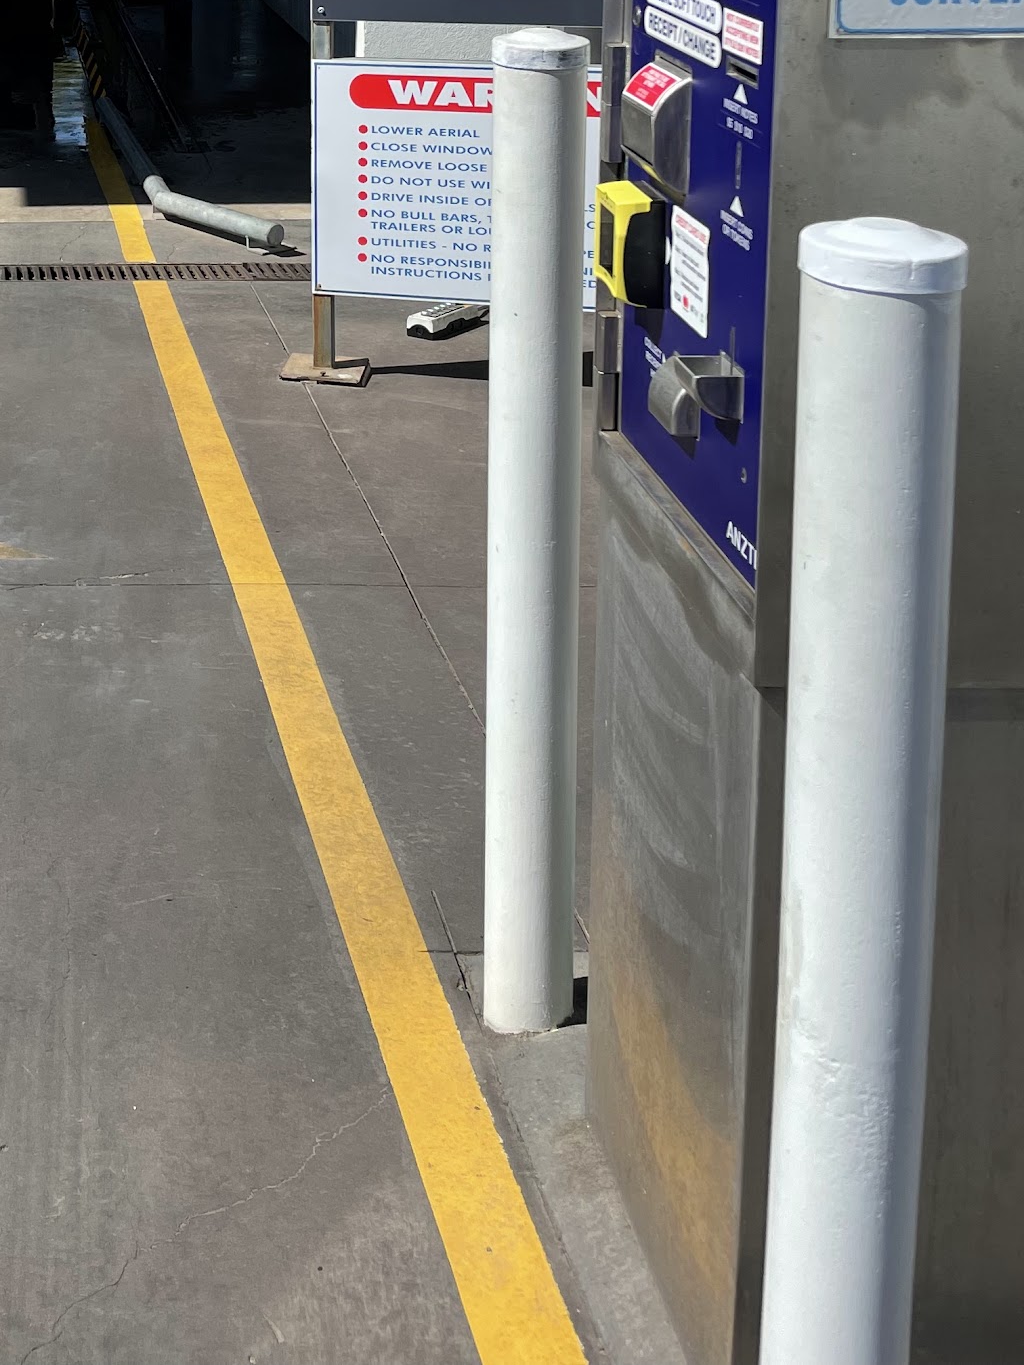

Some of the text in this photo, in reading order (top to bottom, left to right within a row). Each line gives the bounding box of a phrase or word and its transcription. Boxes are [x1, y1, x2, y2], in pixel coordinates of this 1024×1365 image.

[649, 12, 678, 42] RECEIPT
[683, 28, 716, 61] CHANGE
[371, 125, 480, 138] LOWER AERIAL
[371, 142, 418, 153] CLOSE
[371, 159, 487, 172] REMOVE LOOSE
[371, 176, 394, 185] DO
[400, 177, 431, 187] NOT
[437, 179, 465, 188] USE
[371, 192, 469, 205] DRIVE INSIDE
[371, 209, 395, 219] NO
[401, 211, 435, 221] BULL
[441, 213, 482, 225] BARS,
[371, 221, 463, 234] TRAILERS OR
[371, 237, 477, 252] UTILITIES NO
[371, 254, 395, 264] NO
[371, 266, 482, 281] INSTRUCTIONS
